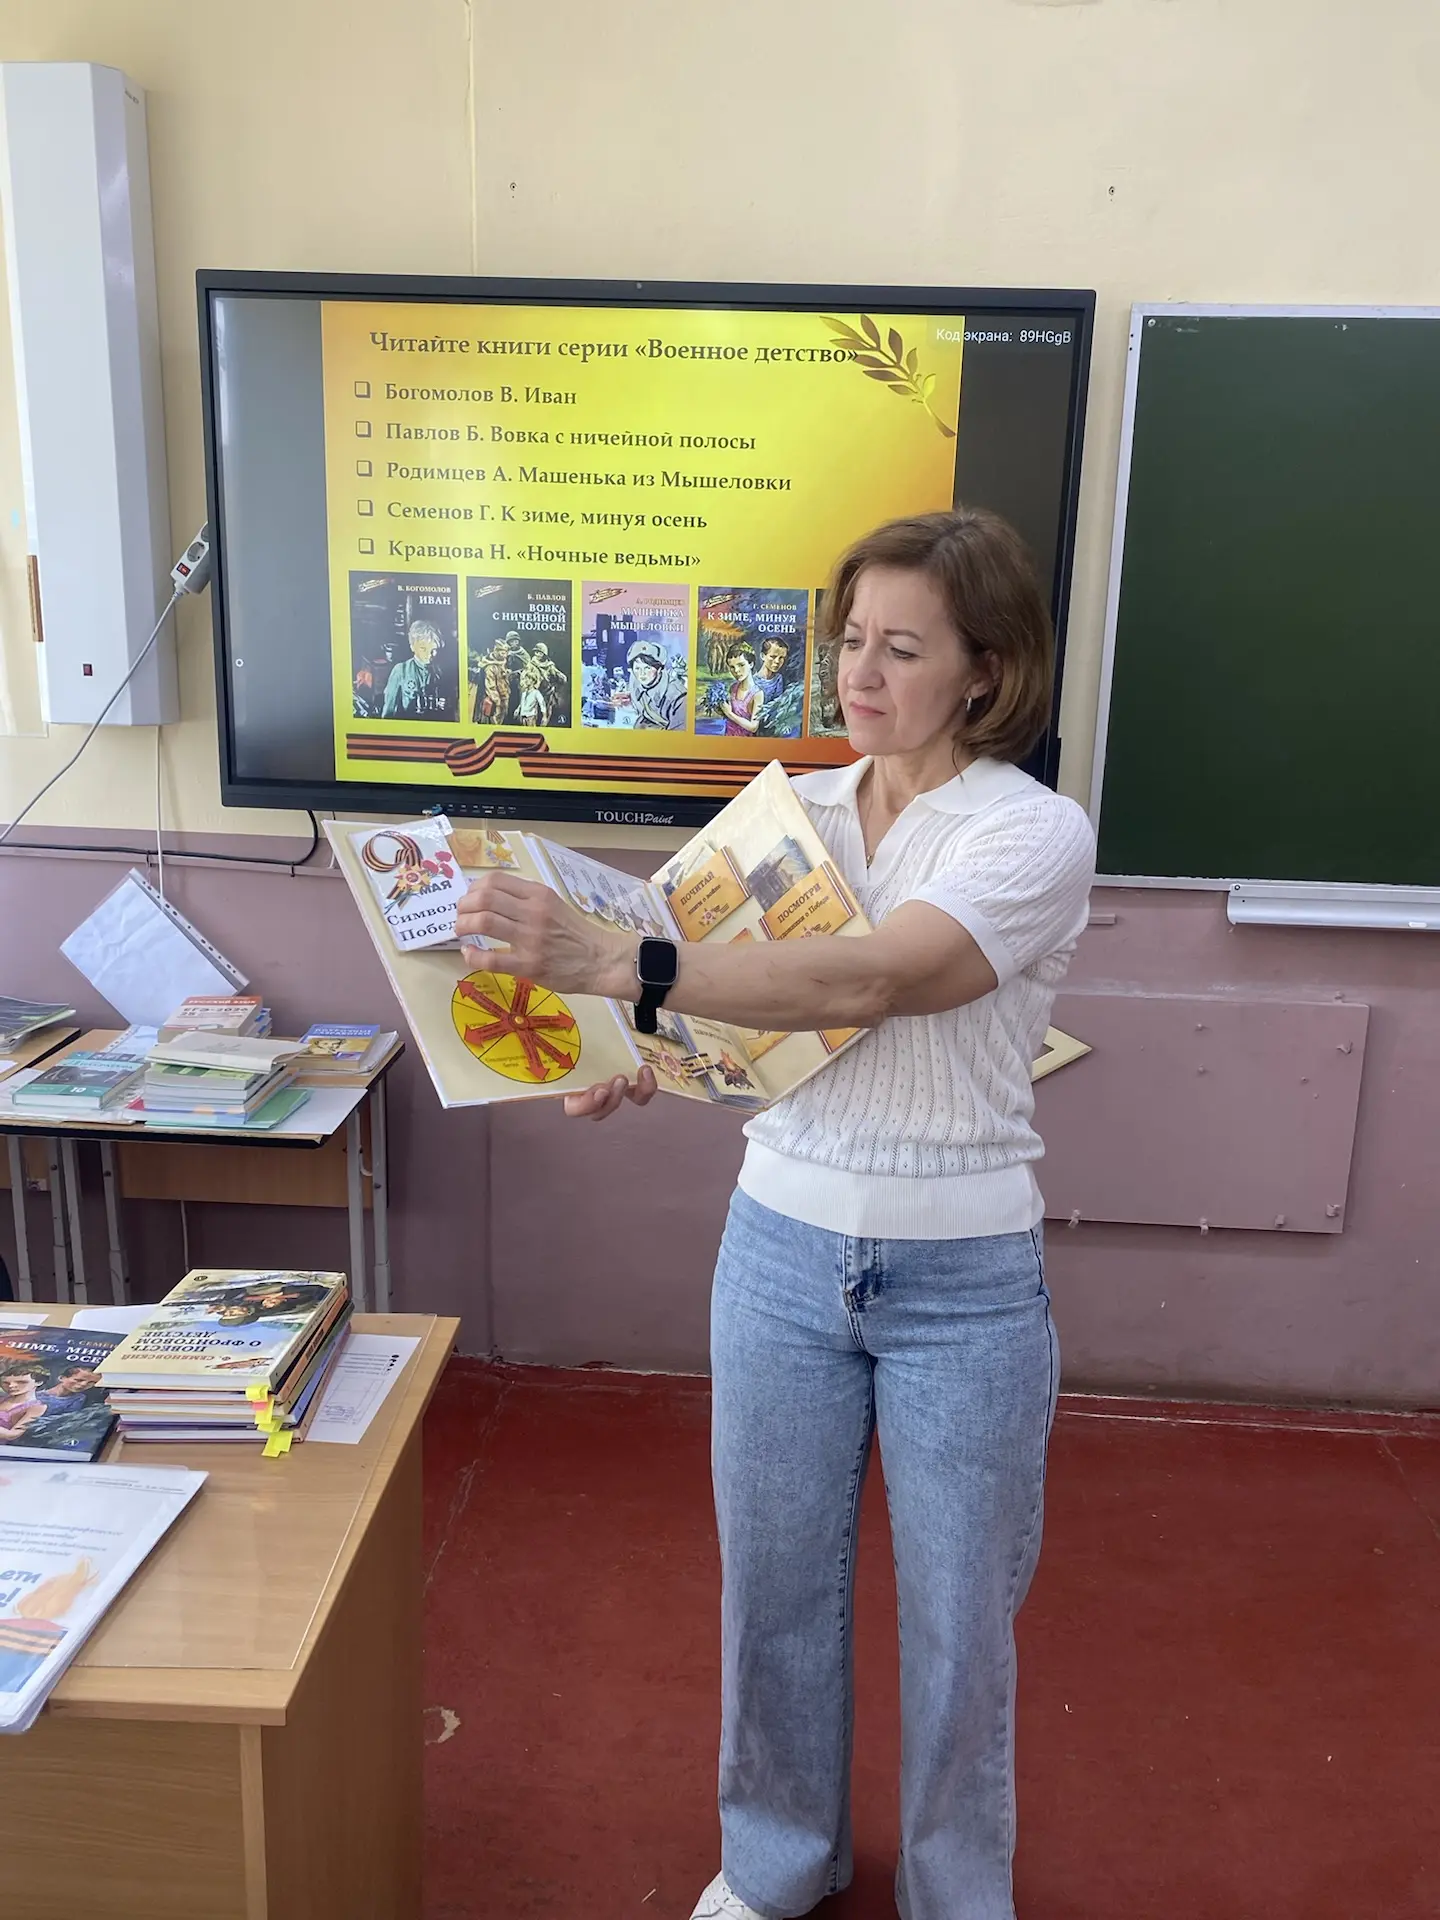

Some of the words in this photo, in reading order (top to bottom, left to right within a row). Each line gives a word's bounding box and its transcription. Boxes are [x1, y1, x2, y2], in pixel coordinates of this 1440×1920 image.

[936, 328, 960, 341] Код
[964, 330, 1013, 344] экрана:
[1019, 329, 1072, 346] 89HGgB
[370, 331, 470, 354] Читайте
[476, 338, 551, 356] книги
[558, 342, 629, 362] серии
[635, 338, 748, 361] «Военное
[754, 346, 858, 364] детство»
[385, 383, 494, 402] Богомолов
[501, 386, 518, 403] В.
[524, 387, 577, 404] Иван
[386, 423, 460, 442] Павлов
[466, 425, 484, 442] Б.
[491, 426, 549, 444] Вовка
[555, 432, 564, 444] с
[570, 429, 673, 448] ничейной
[679, 435, 756, 450] полосы
[387, 462, 486, 483] Родимцев
[492, 466, 512, 482] А.
[518, 467, 626, 487] Машенька
[632, 475, 655, 488] из
[661, 471, 792, 491] Мышеловки
[387, 502, 473, 521] Семенов
[480, 505, 494, 521] Г.
[501, 506, 516, 522] К
[521, 509, 575, 526] зиме,
[581, 513, 645, 531] минуя
[651, 515, 708, 529] осень
[388, 540, 484, 562] Кравцова
[490, 544, 511, 560] Н.
[517, 545, 608, 564] «Ночные
[614, 552, 701, 568] ведьмы»
[405, 585, 451, 593] БОГОМОЛОВ
[419, 596, 451, 605] ИВАН
[536, 593, 566, 601] ПАВЛОВ
[529, 603, 566, 613] ВОВКА
[620, 606, 684, 617] МАШЕНЬКА
[761, 603, 797, 611] СЕМЕНОВ
[492, 612, 500, 621] С
[501, 611, 566, 623] НИЧЕЙНОЙ
[707, 611, 714, 620] К
[718, 611, 752, 623] ЗИМЕ,
[755, 613, 796, 623] МИНУЯ
[516, 621, 566, 632] ПОЛОСЫ
[610, 621, 684, 632] МЫШЕЛОВКИ
[758, 623, 796, 633] ОСЕНЬ
[420, 879, 452, 896] МАЯ
[777, 882, 822, 923] ПОСМОТРИ
[387, 902, 457, 926] Символ
[5, 1340, 60, 1353] ЗИМЕ,
[79, 1340, 117, 1349] СЕМЕН
[135, 1337, 245, 1346] ФРОНТОВОМ
[66, 1346, 108, 1357] МИН
[131, 1344, 207, 1352] ПОВЕСТЬ
[66, 1354, 103, 1364] ОСЕ
